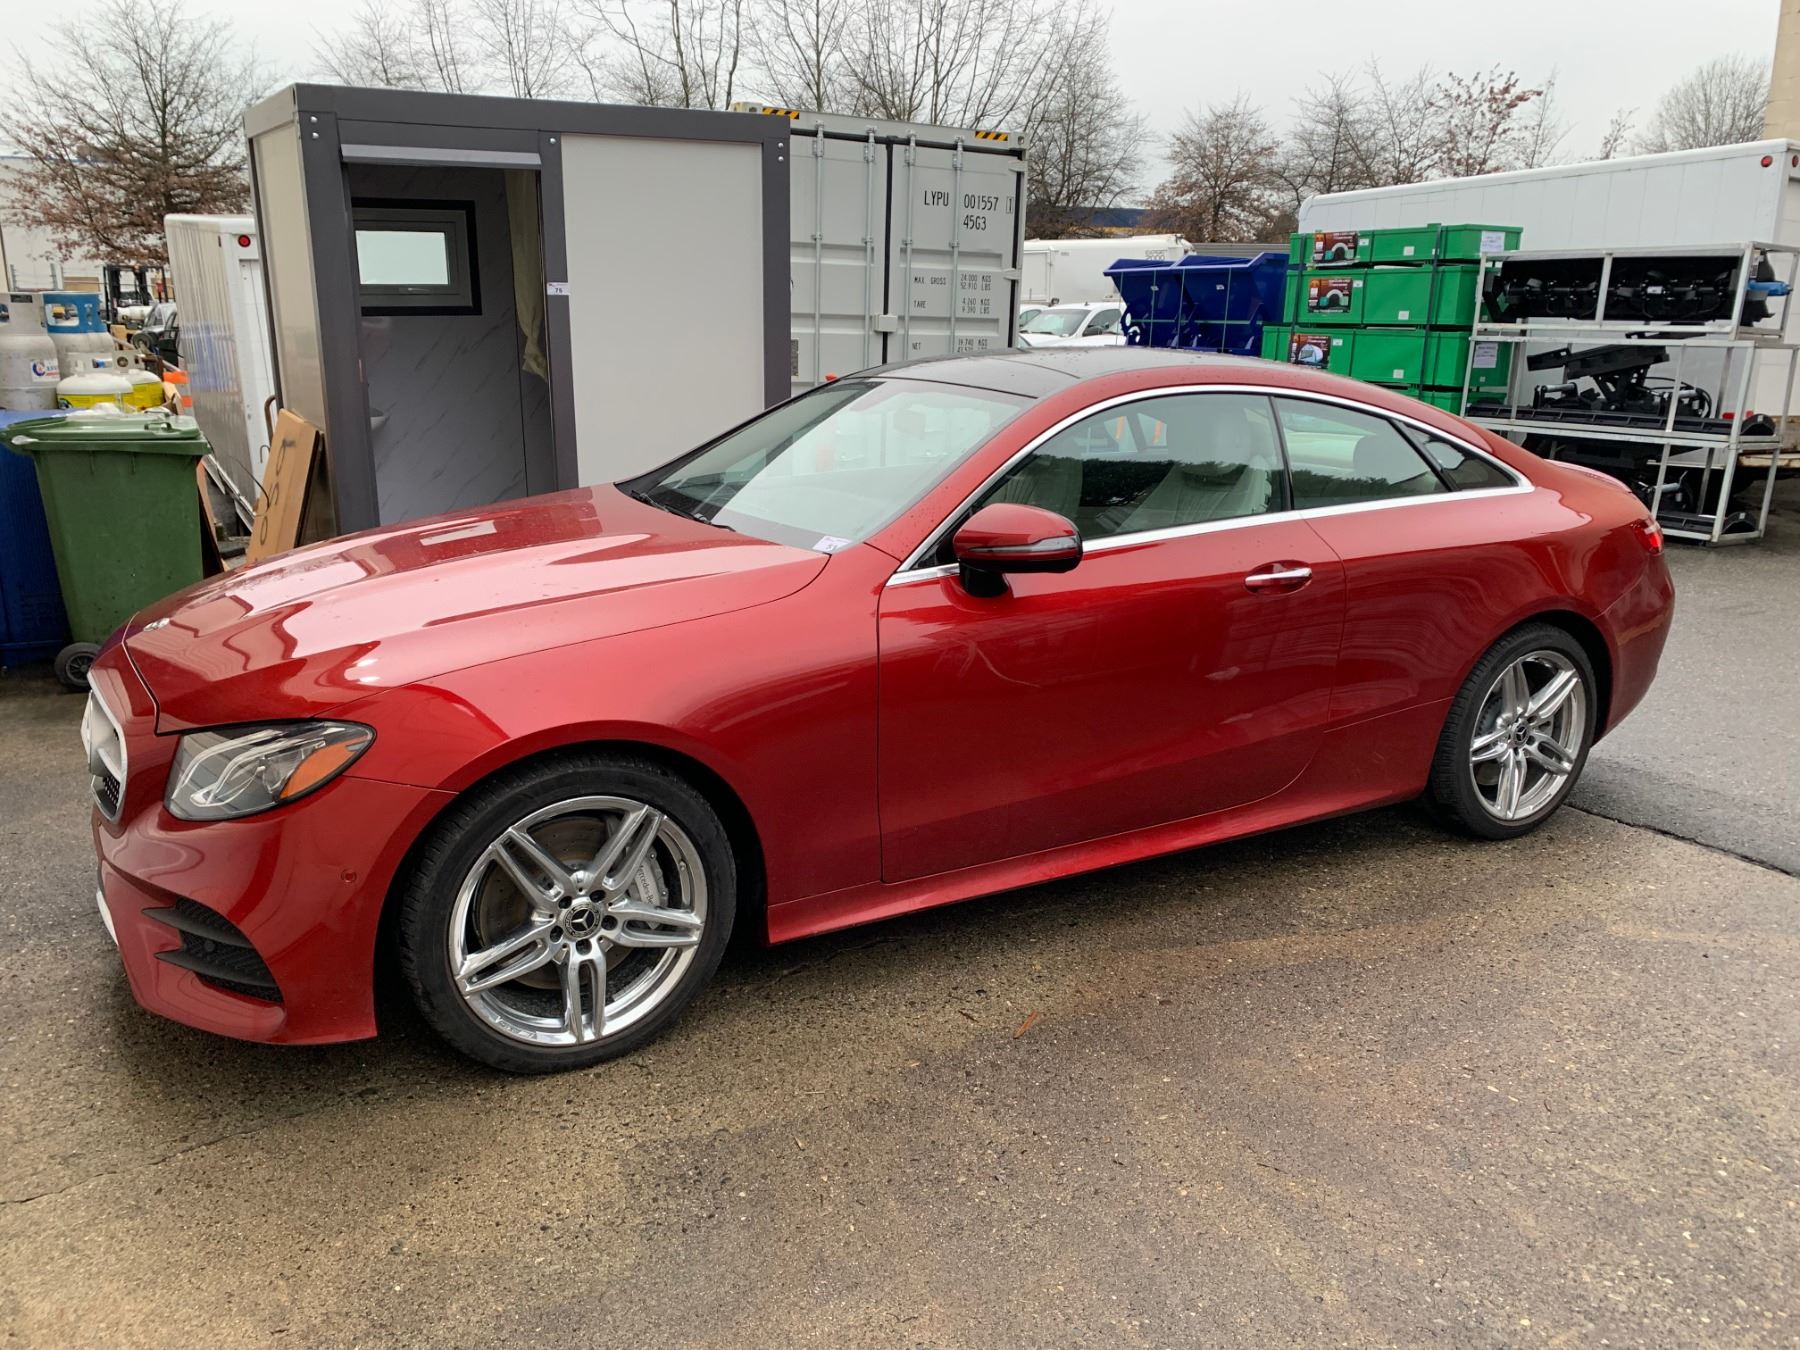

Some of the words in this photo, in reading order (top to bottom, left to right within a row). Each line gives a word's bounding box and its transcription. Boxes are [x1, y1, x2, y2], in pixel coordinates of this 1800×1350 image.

[924, 190, 949, 207] LYPU
[963, 193, 999, 211] 001557
[963, 214, 987, 231] 45G3
[913, 276, 925, 285] MAX
[930, 276, 947, 285] GROSS
[981, 274, 992, 283] KGS
[981, 283, 991, 291] LBS
[913, 300, 927, 309] TARE
[912, 342, 921, 350] NET
